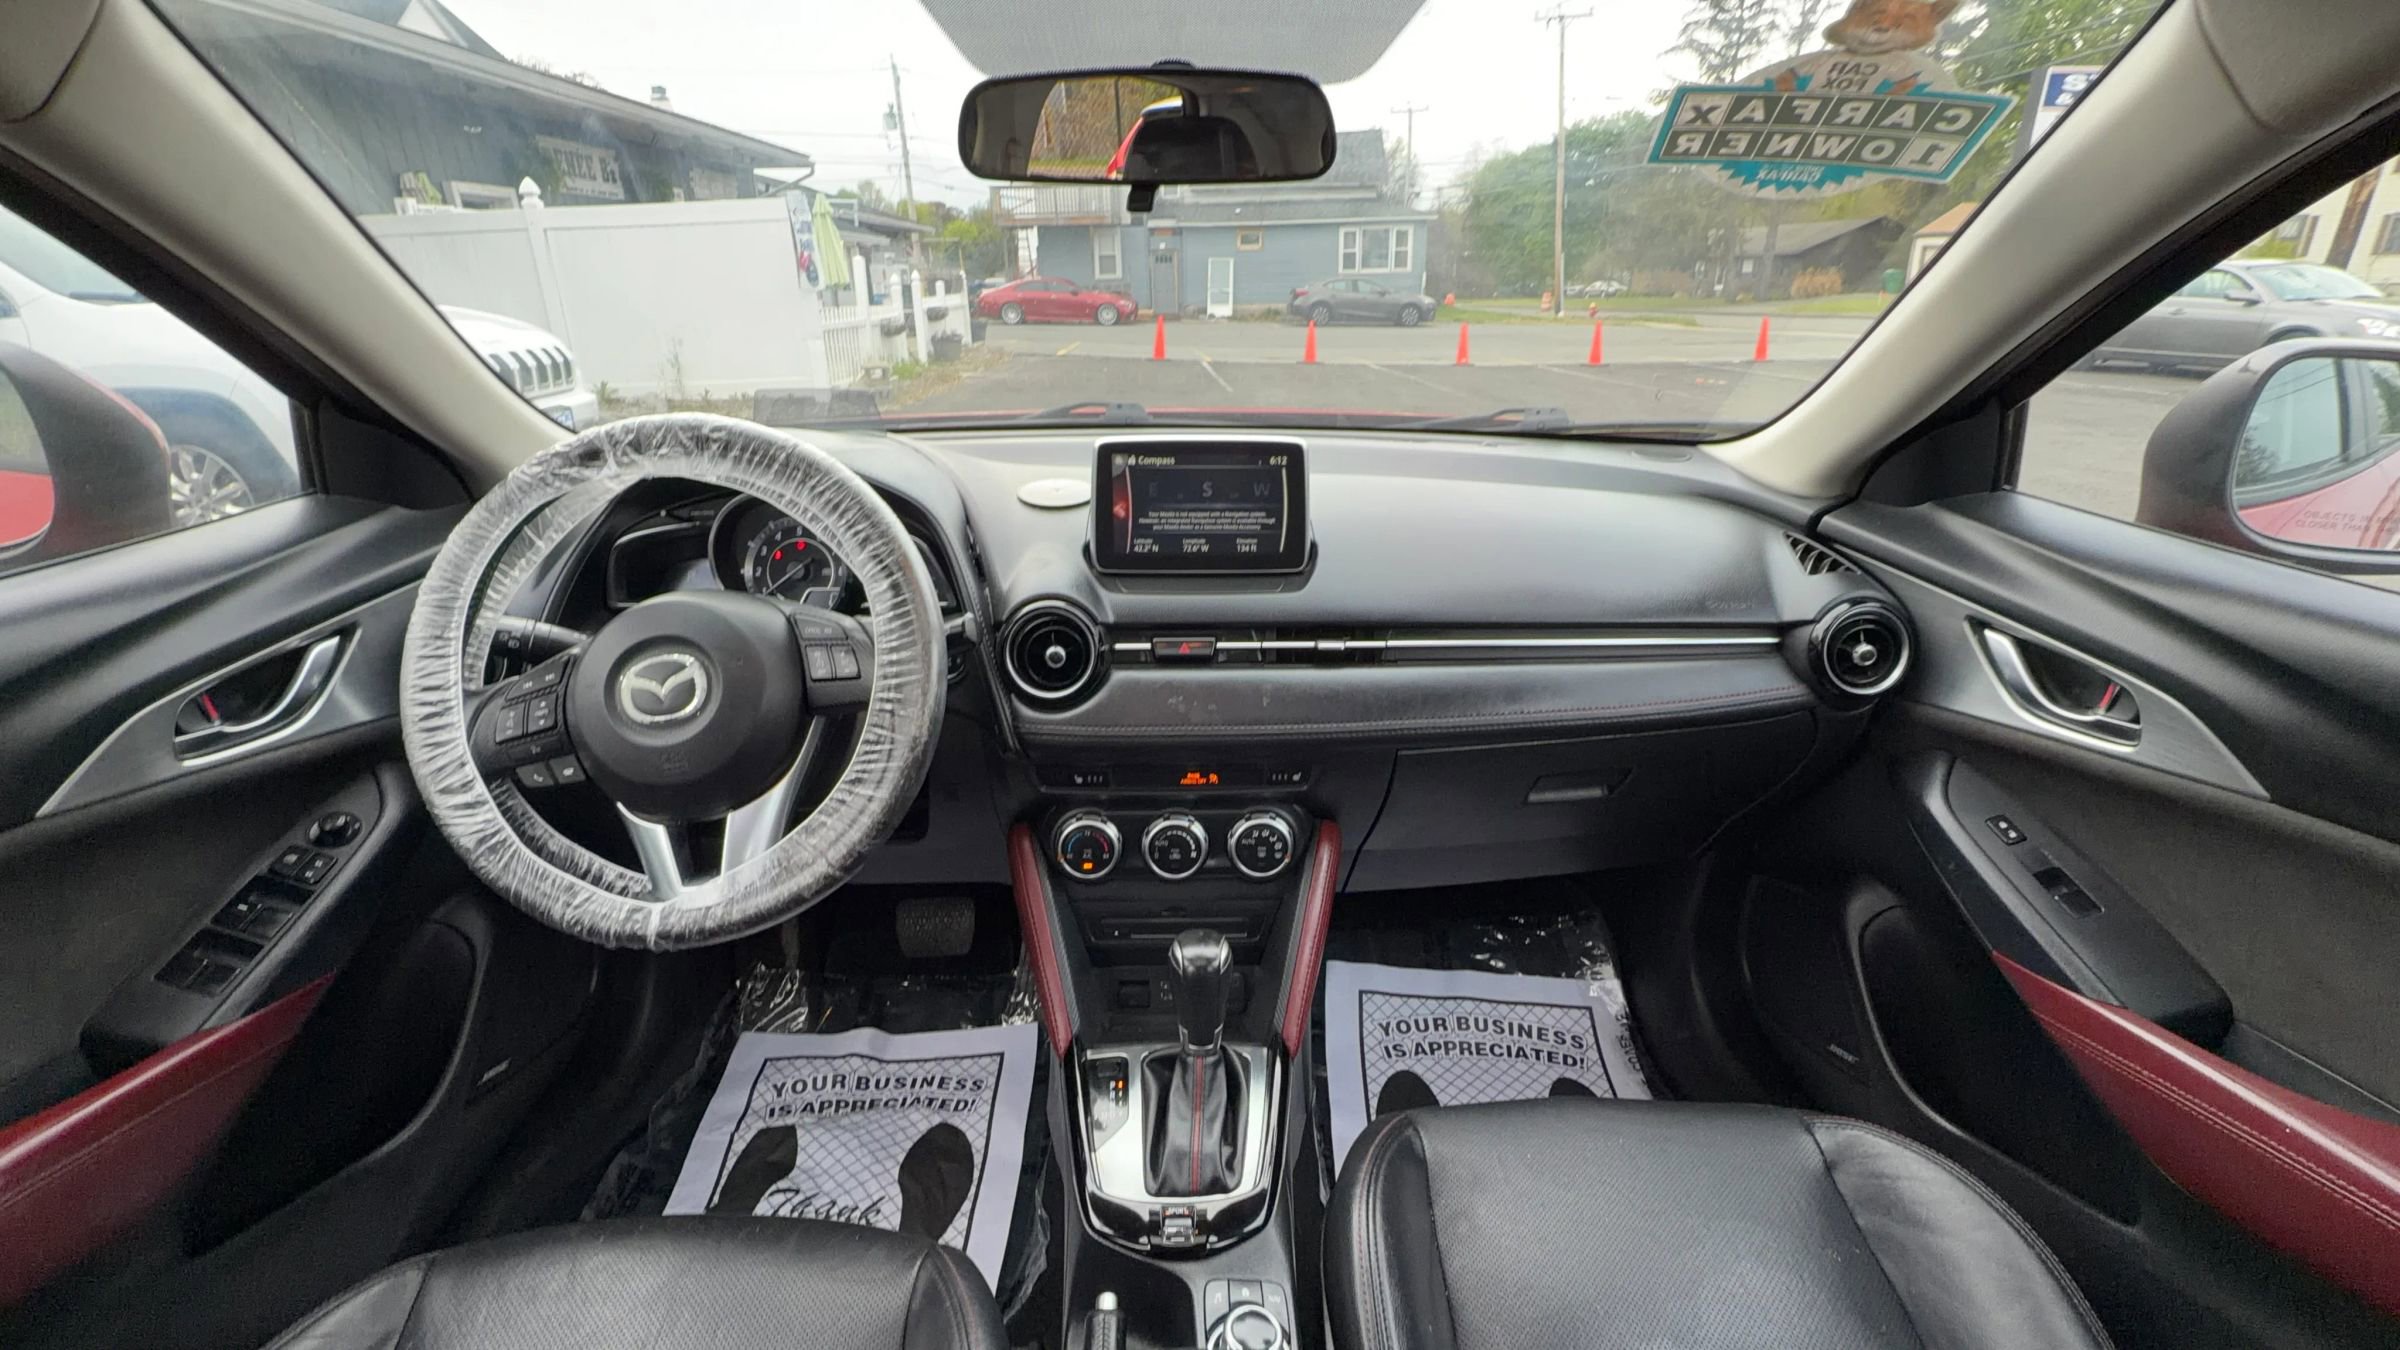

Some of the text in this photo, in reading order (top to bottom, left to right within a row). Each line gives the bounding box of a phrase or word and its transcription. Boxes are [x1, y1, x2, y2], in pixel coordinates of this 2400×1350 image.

[1138, 455, 1176, 467] Compass
[1202, 482, 1214, 497] S
[1254, 482, 1271, 497] W
[1378, 1016, 1449, 1037] YOUR
[1455, 1016, 1585, 1050] BUSINESS
[1383, 1040, 1586, 1070] IS APPRECIATED!
[772, 1074, 985, 1098] YOUR BUSINESS
[768, 1096, 977, 1118] IS APPRECIATED!
